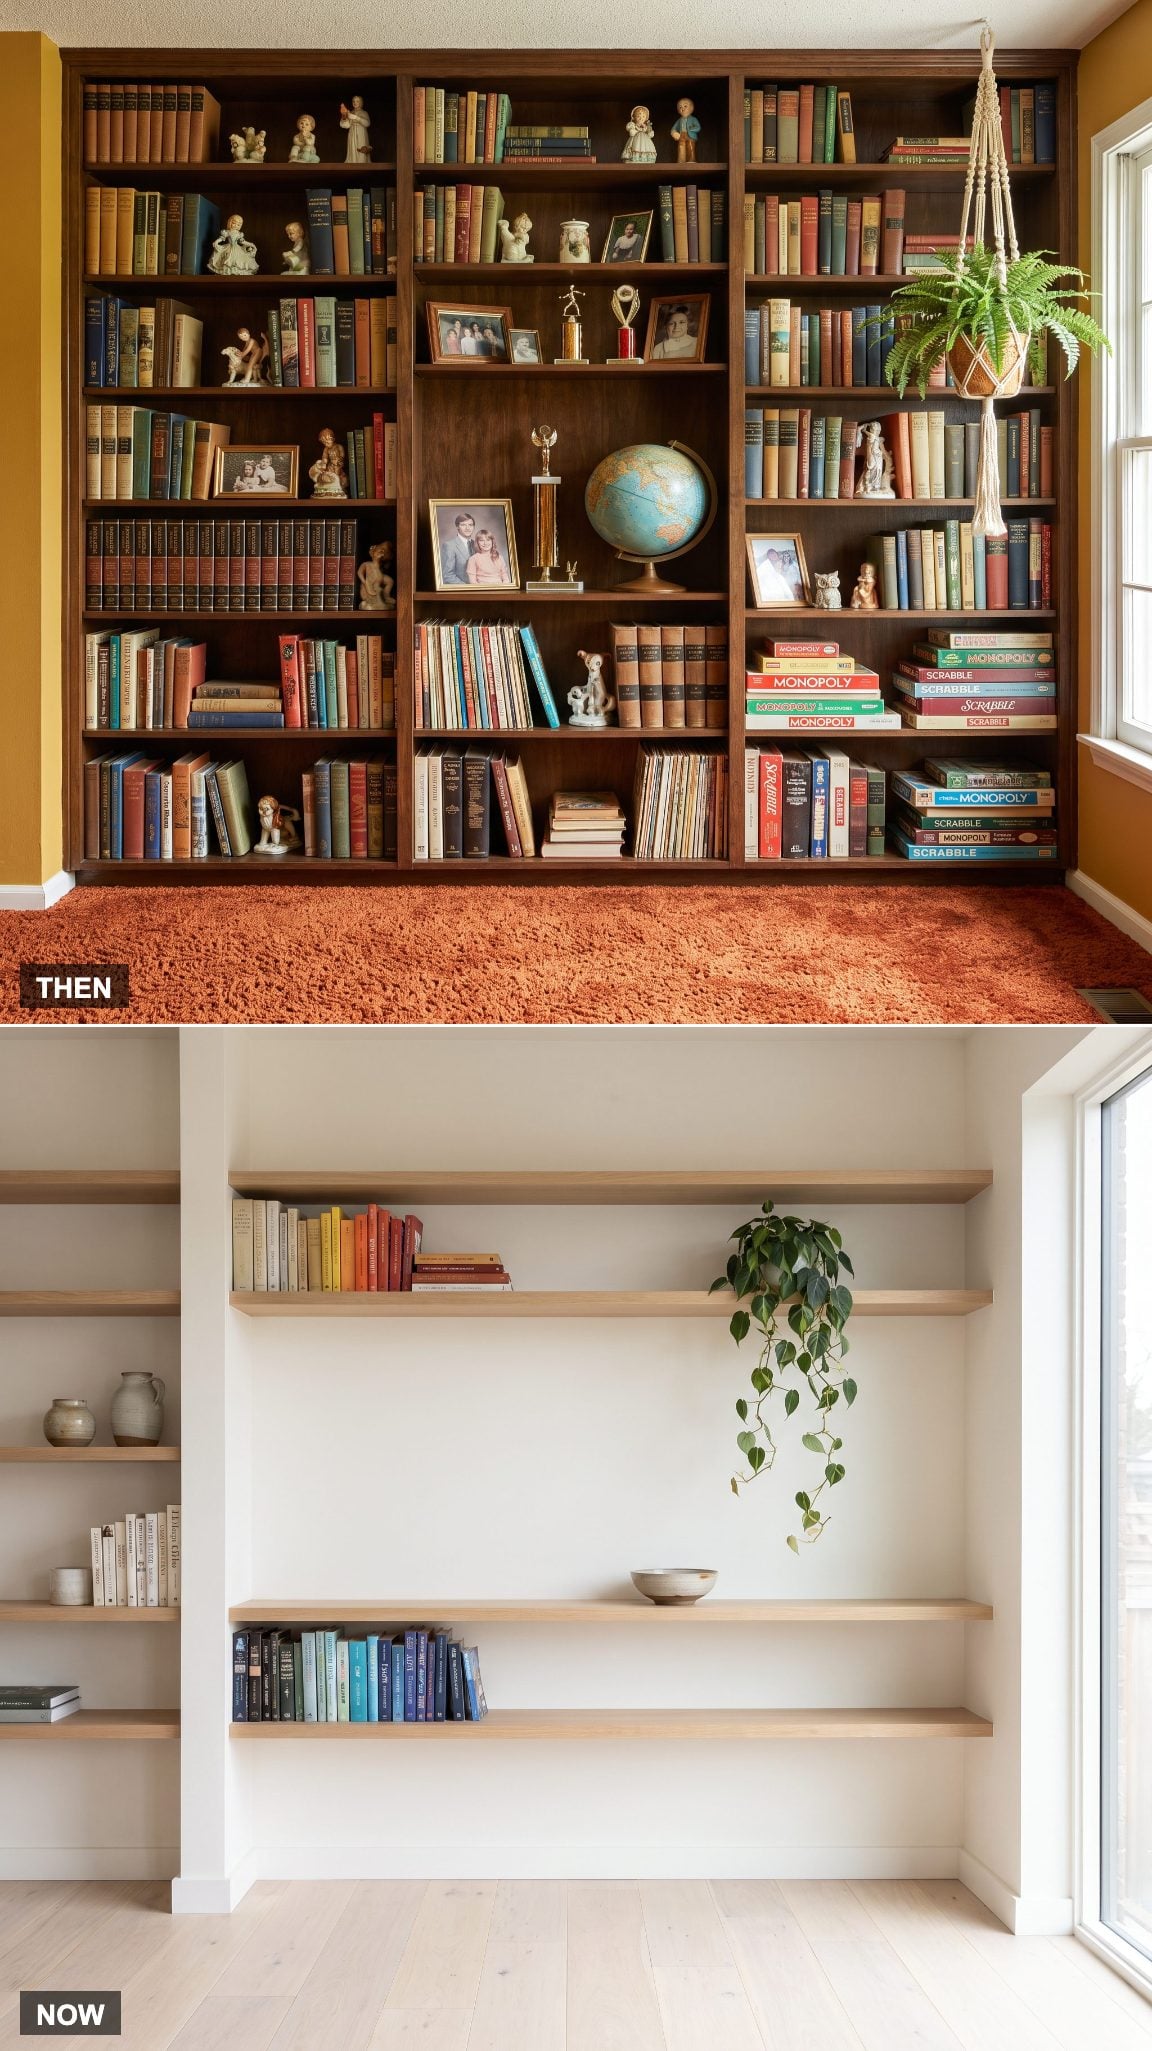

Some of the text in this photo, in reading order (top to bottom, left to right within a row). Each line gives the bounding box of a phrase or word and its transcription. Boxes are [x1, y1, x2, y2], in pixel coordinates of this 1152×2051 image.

[966, 653, 1036, 664] MONOPOLY
[926, 671, 973, 680] SCRABBLE
[774, 677, 852, 688] MONOPOLY
[921, 685, 981, 694] SCRABBLE
[756, 702, 817, 712] MONOPOLY
[961, 699, 1016, 714] SCRABBLE
[789, 717, 853, 727] MONOPOLY
[969, 718, 1008, 726] SCRABBLE
[764, 761, 778, 816] SCRABBLE
[959, 793, 1029, 803] MONOPOLY
[934, 819, 982, 828] SCRABBLE
[943, 834, 988, 842] MONOPOLY
[913, 848, 977, 857] SCRABBLE
